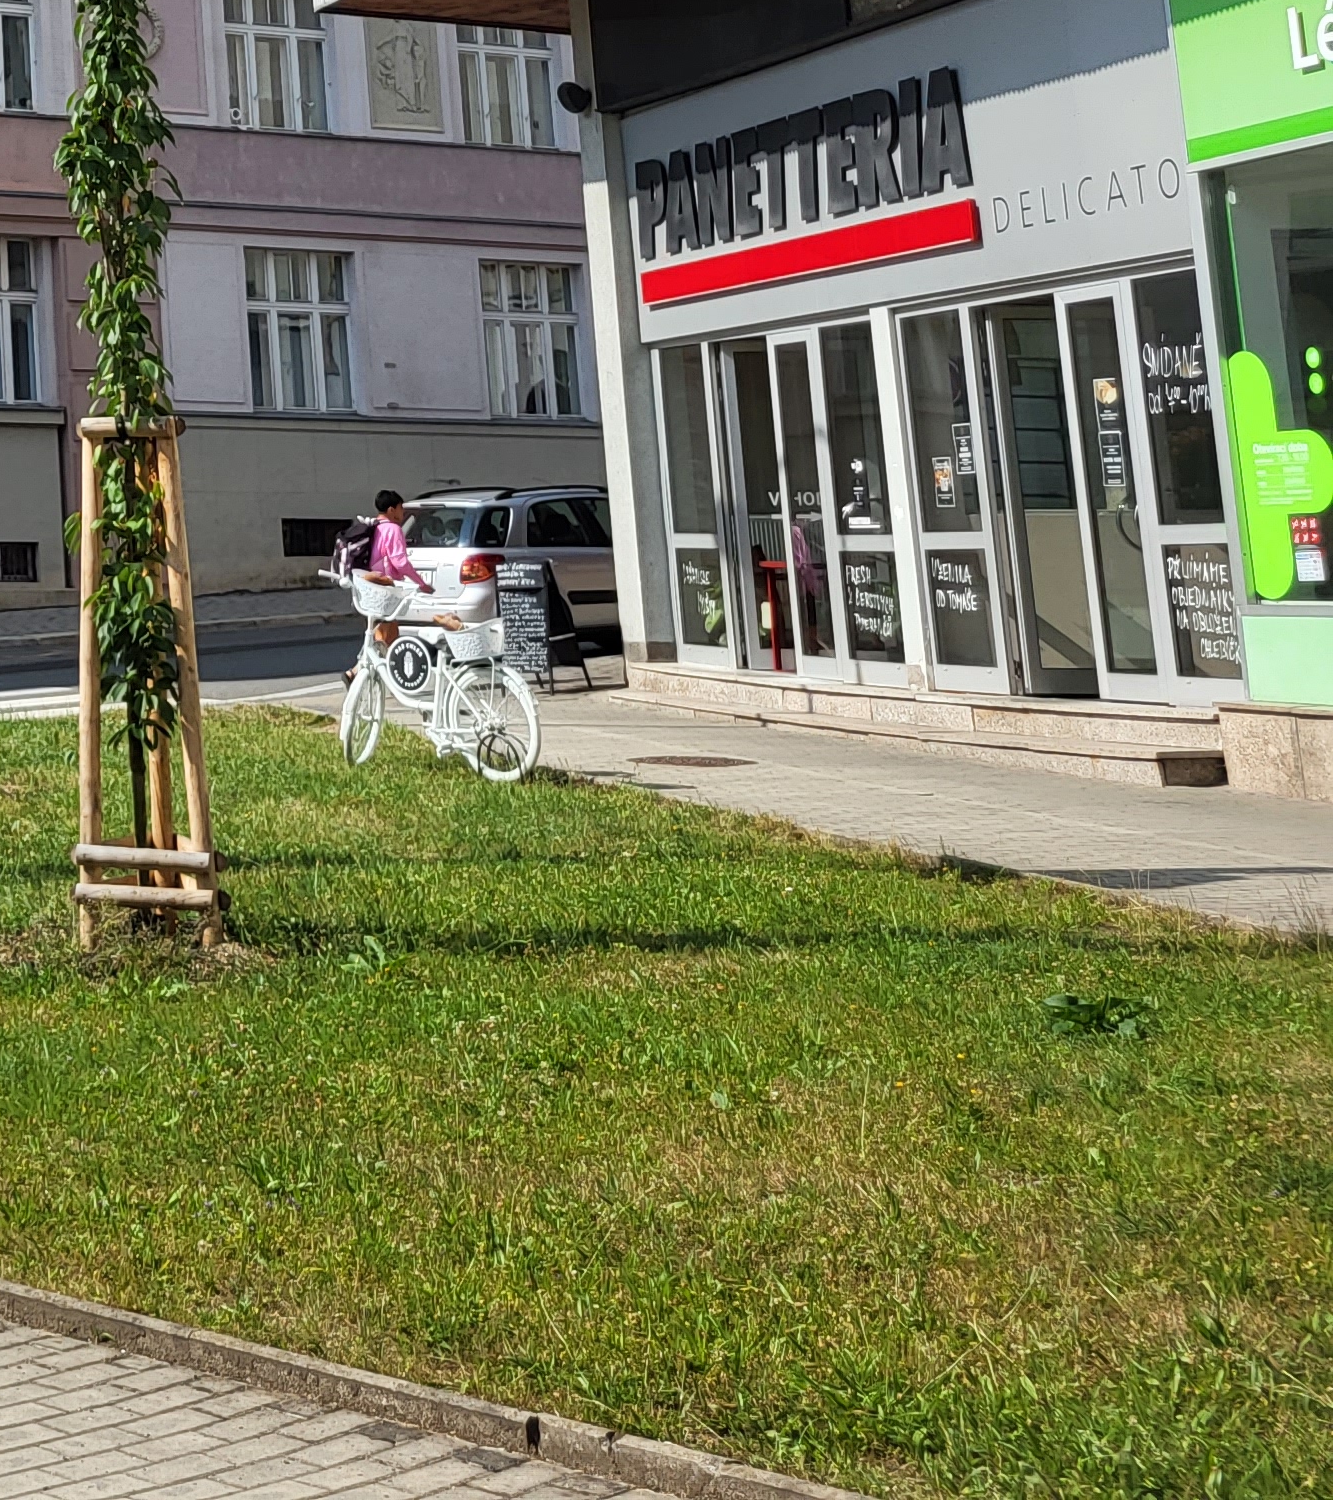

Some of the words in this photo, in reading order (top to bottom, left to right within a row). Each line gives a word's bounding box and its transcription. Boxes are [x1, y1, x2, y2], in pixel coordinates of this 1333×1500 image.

[635, 66, 975, 263] PANETTERIA
[991, 158, 1181, 235] DELICATO
[1141, 331, 1203, 379] SNÍDANĚ
[845, 564, 872, 586] FRESH
[935, 588, 946, 608] OD
[946, 586, 978, 615] TOMÁŠE
[1176, 608, 1190, 630] NA
